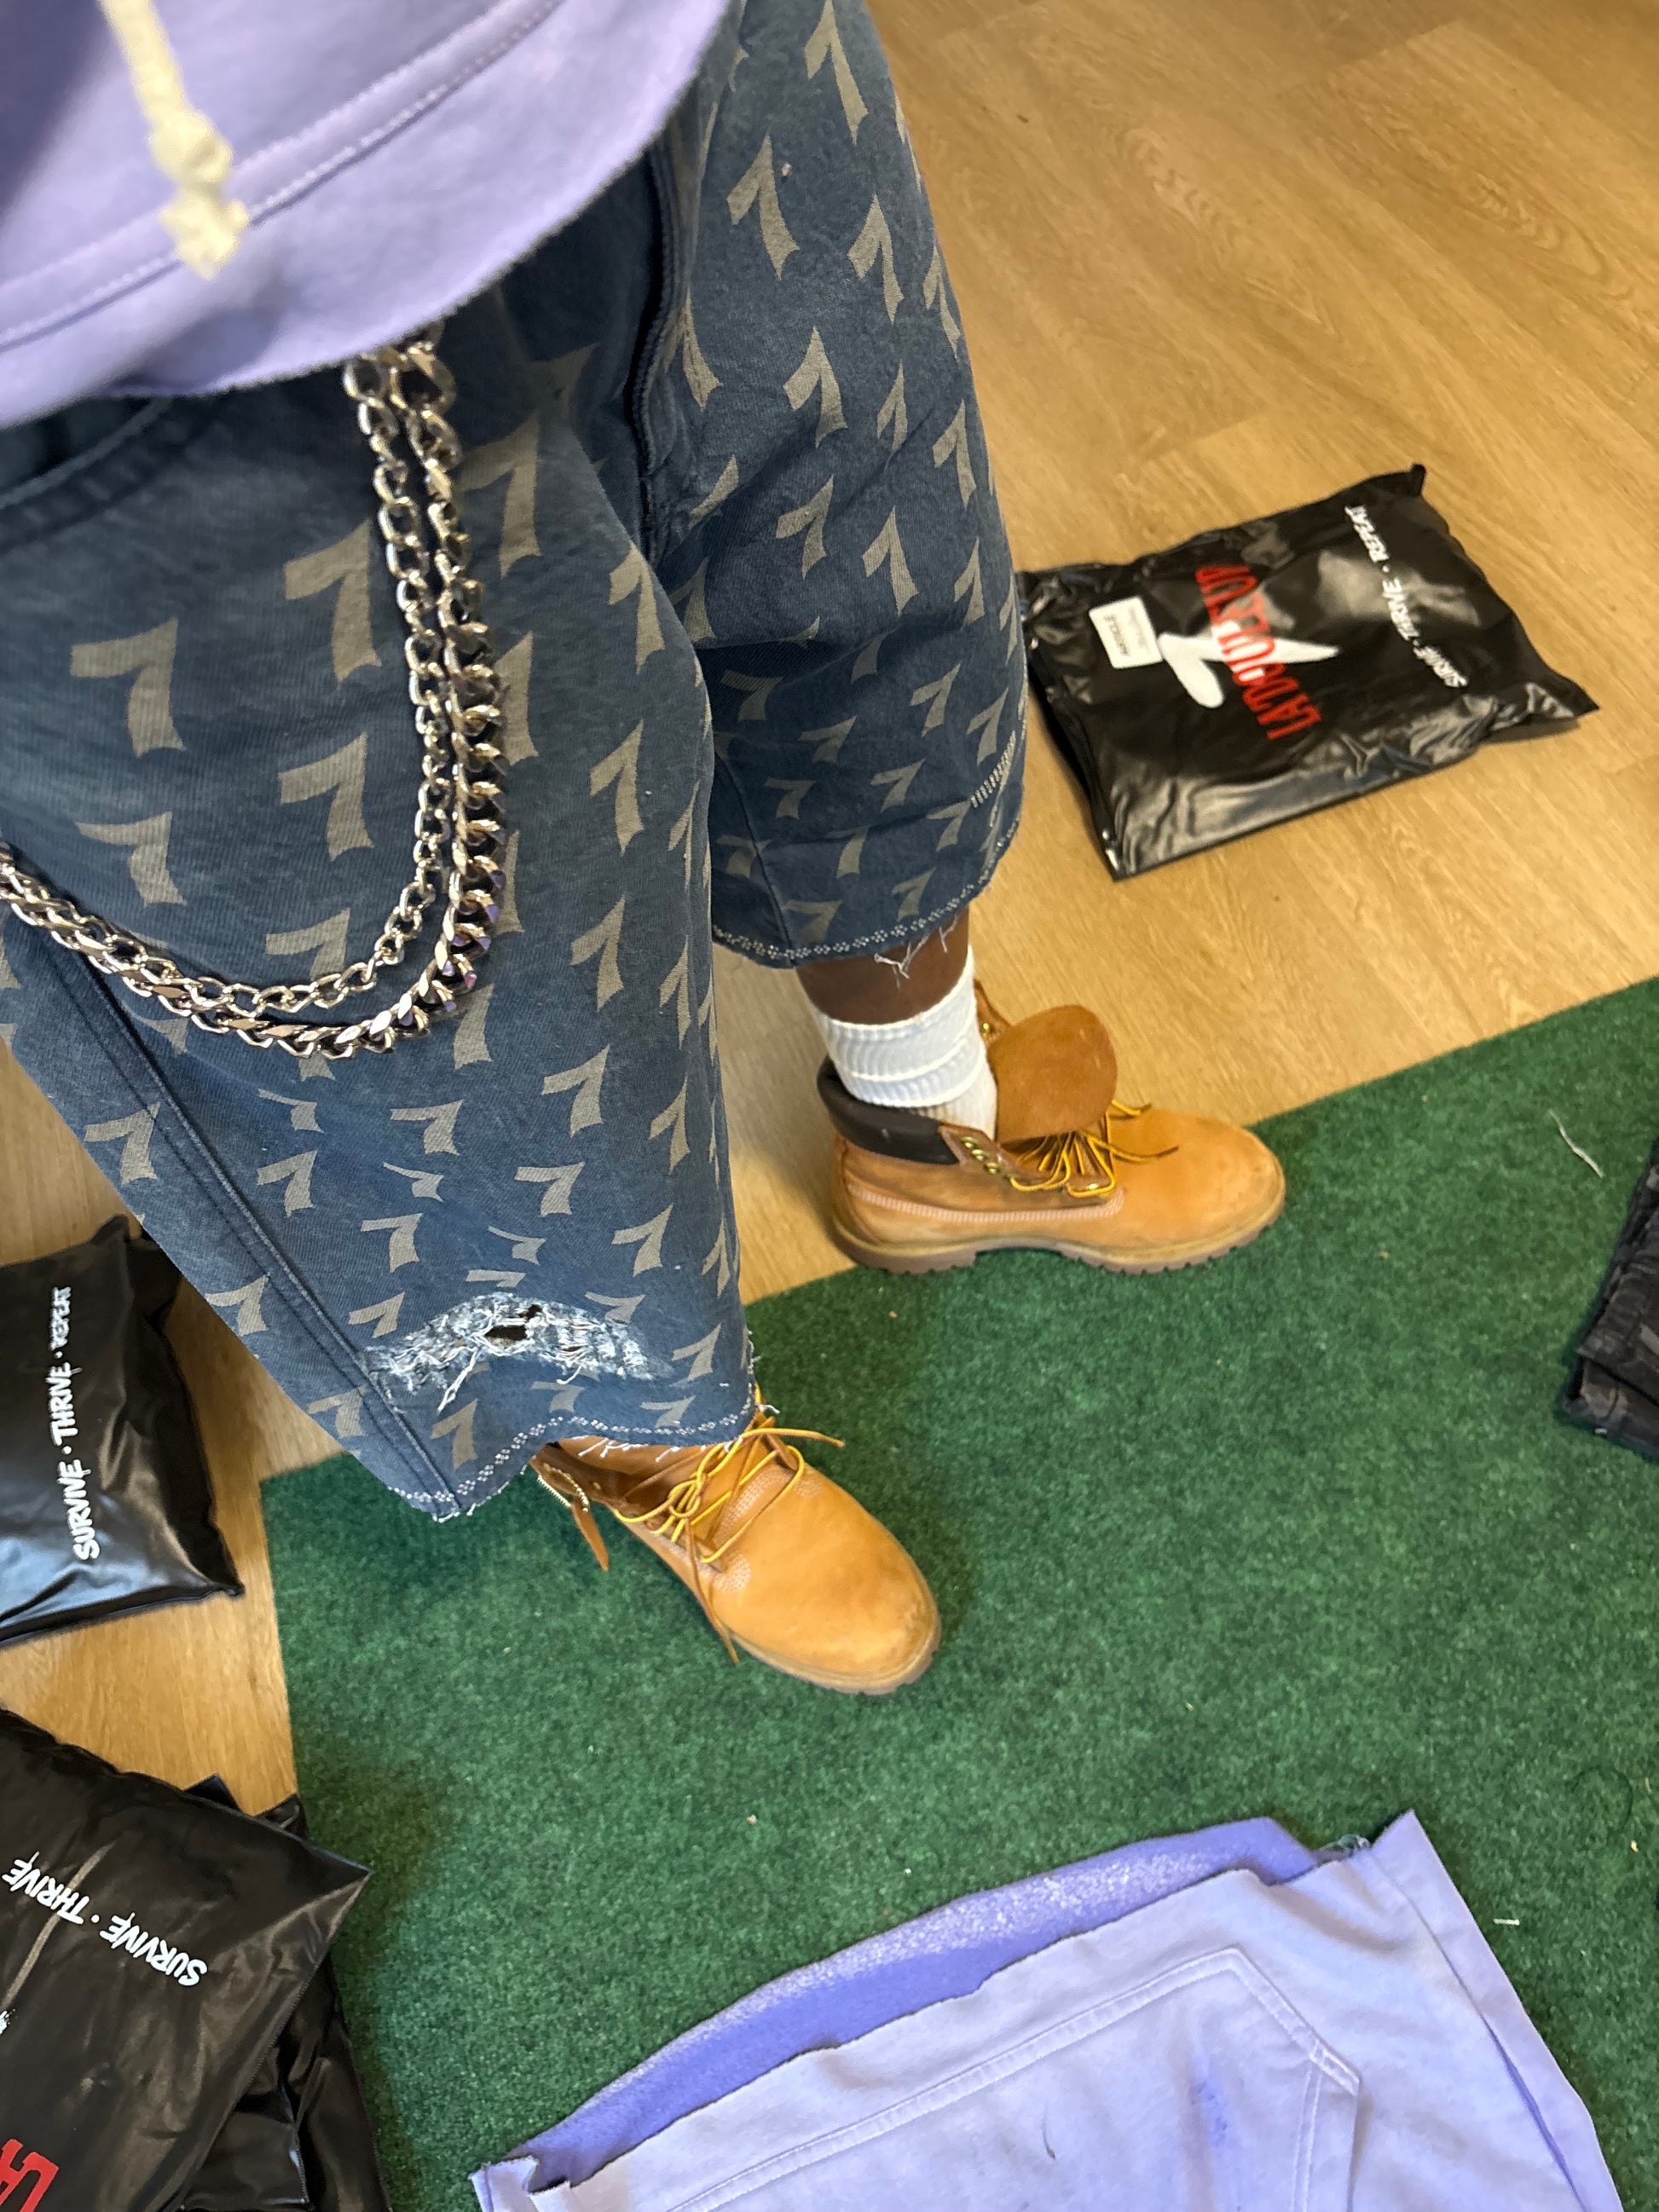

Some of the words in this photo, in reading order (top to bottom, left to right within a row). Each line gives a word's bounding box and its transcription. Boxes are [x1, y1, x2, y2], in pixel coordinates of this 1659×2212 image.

[1344, 505, 1390, 563] REPEAT
[1381, 576, 1420, 641] THRIVE
[49, 1285, 72, 1350] REPEAT
[45, 1361, 84, 1447] THRIVE
[56, 1458, 101, 1562] SURVIVE
[3, 1851, 90, 1925] THRIVE
[100, 1912, 208, 1987] SURVIVE
